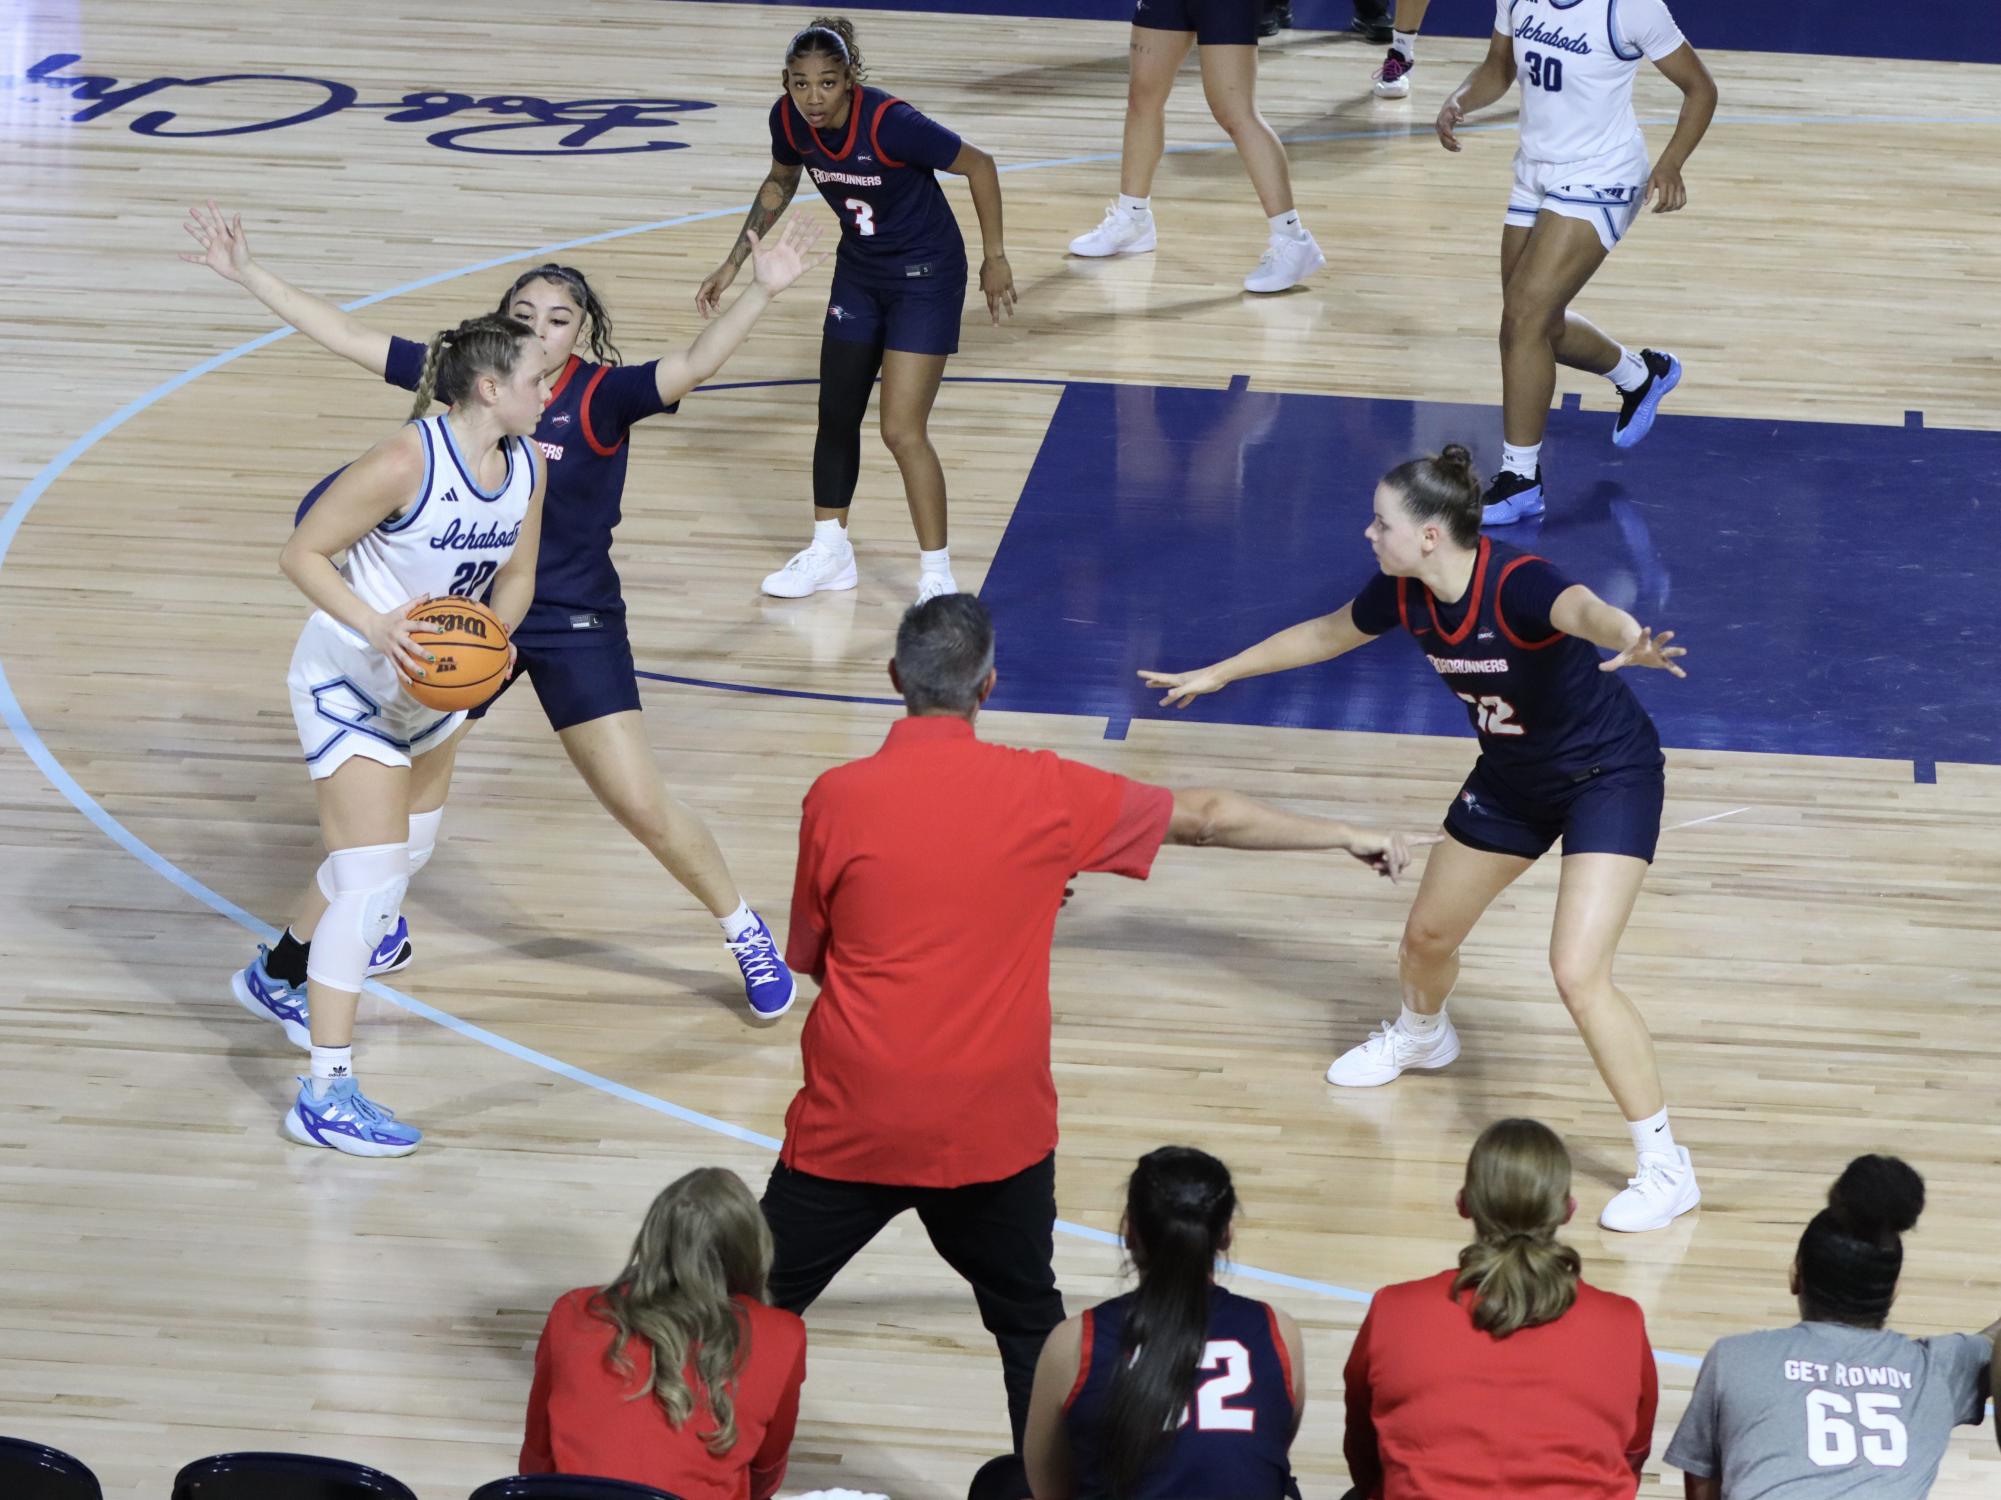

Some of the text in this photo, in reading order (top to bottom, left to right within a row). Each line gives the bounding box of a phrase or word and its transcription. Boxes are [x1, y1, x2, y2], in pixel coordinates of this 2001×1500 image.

[1514, 14, 1593, 55] Ichabods
[1524, 50, 1563, 92] 30
[844, 198, 877, 236] 3
[1784, 1359, 1914, 1390] GET ROWDY
[1805, 1388, 1909, 1467] 65
